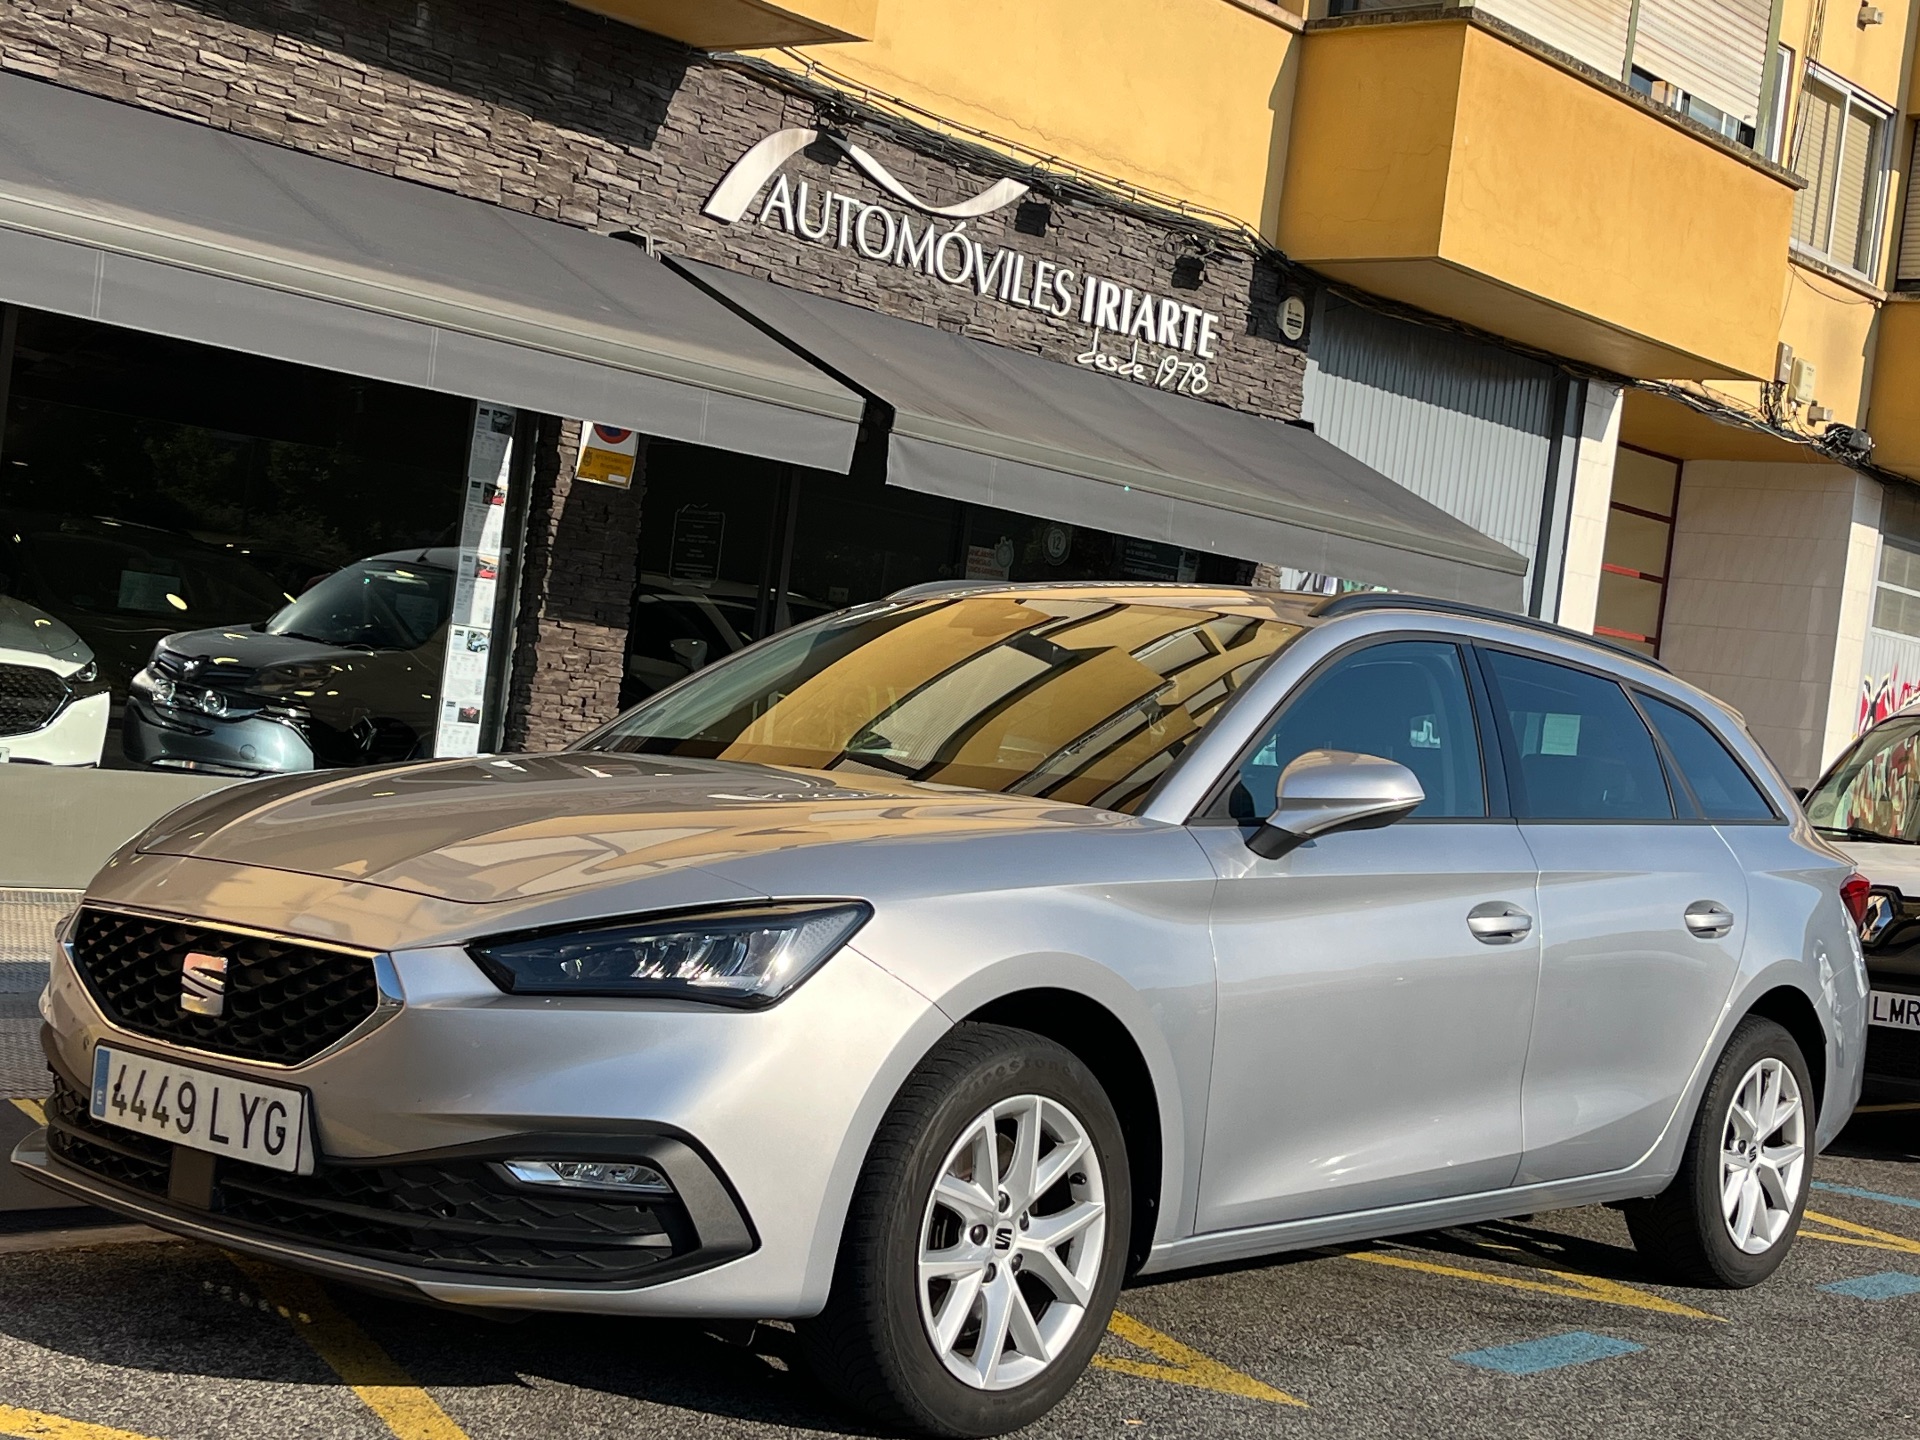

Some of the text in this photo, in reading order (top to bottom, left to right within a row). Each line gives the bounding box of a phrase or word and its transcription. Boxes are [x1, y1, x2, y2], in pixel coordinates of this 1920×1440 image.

[760, 173, 1219, 359] AUTOMÓVILES IRIARTE
[1075, 326, 1209, 394] desde 1978
[1873, 996, 1920, 1026] LMR
[111, 1064, 287, 1155] 4449 LYG
